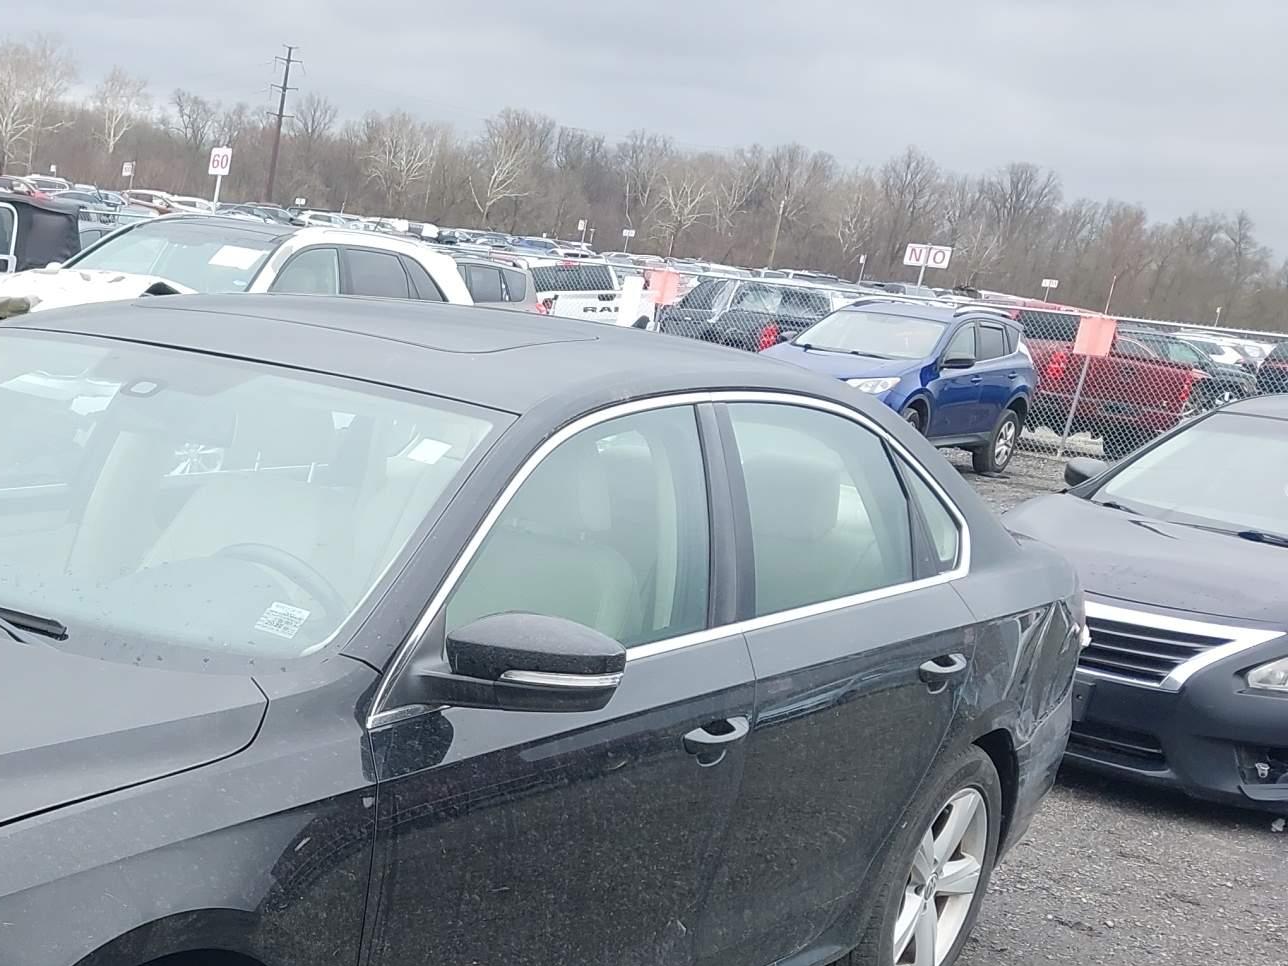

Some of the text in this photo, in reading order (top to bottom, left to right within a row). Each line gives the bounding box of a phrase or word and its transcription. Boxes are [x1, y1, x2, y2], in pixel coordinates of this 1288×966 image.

[211, 153, 229, 169] 60
[908, 247, 946, 265] N O
